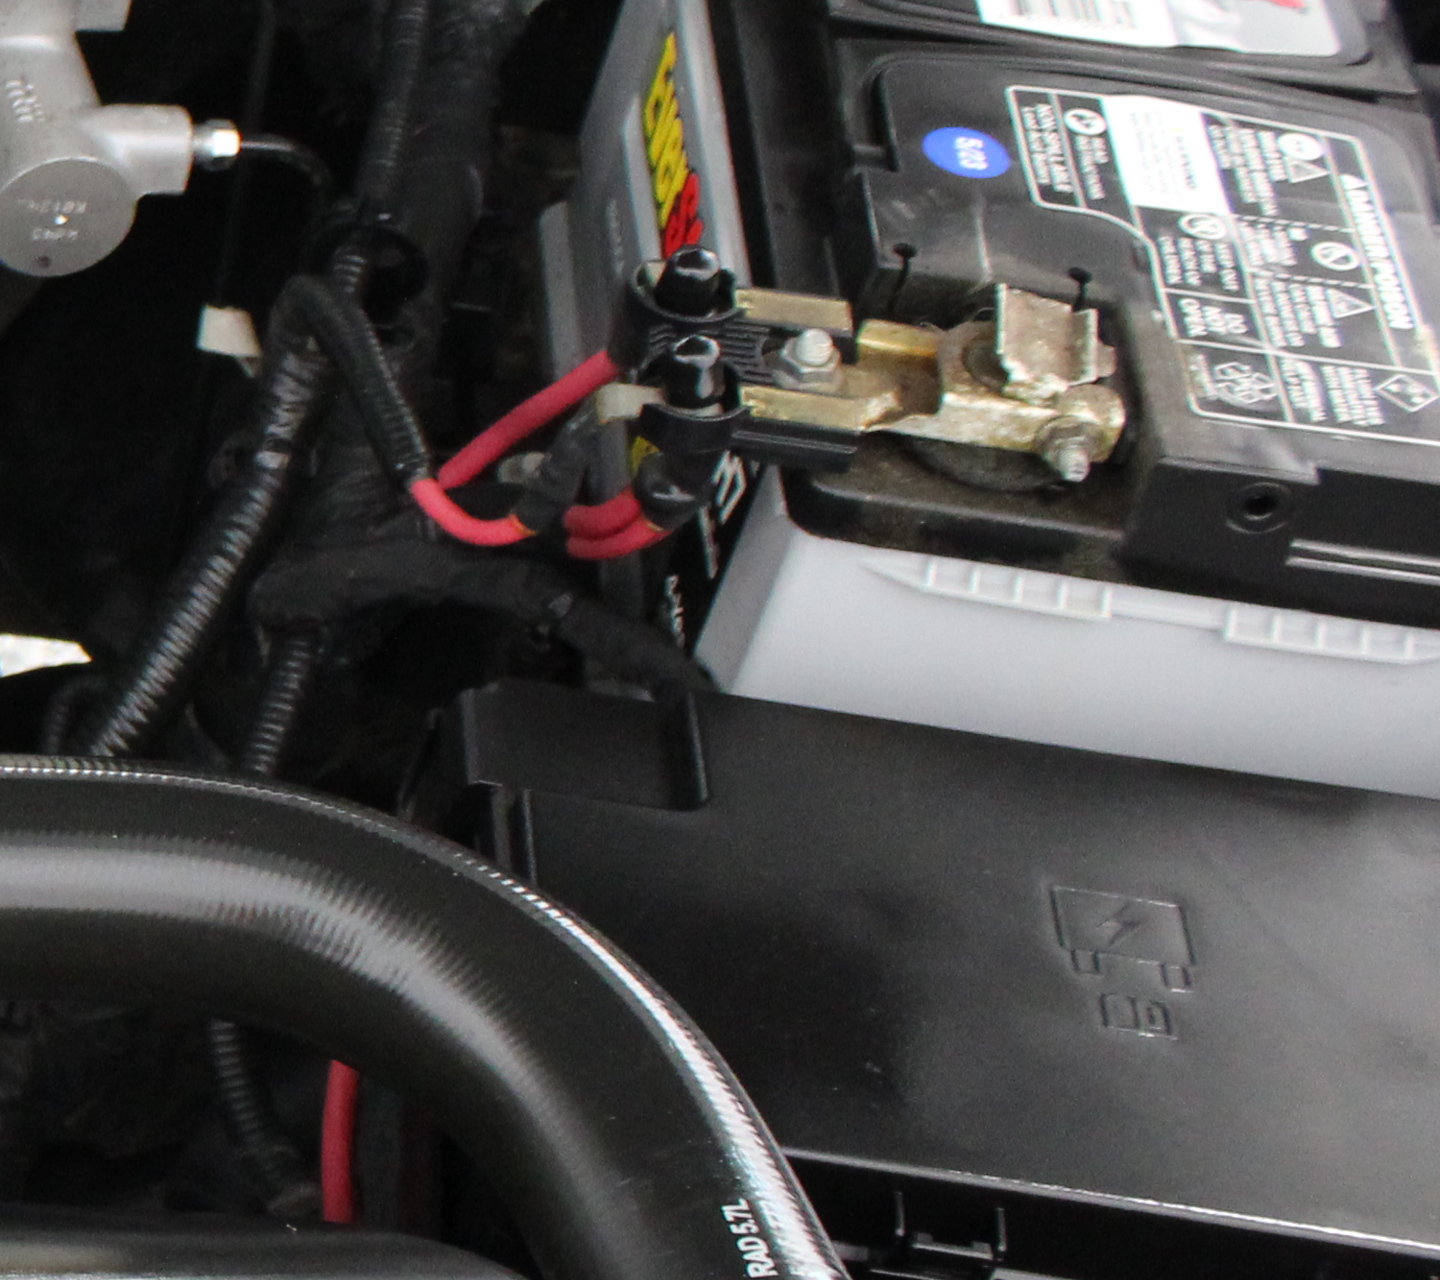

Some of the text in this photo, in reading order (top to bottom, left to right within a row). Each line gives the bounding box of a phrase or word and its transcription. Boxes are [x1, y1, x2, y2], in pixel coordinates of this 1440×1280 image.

[952, 136, 988, 172] 5/23
[722, 1198, 779, 1279] RAD 5.7L
